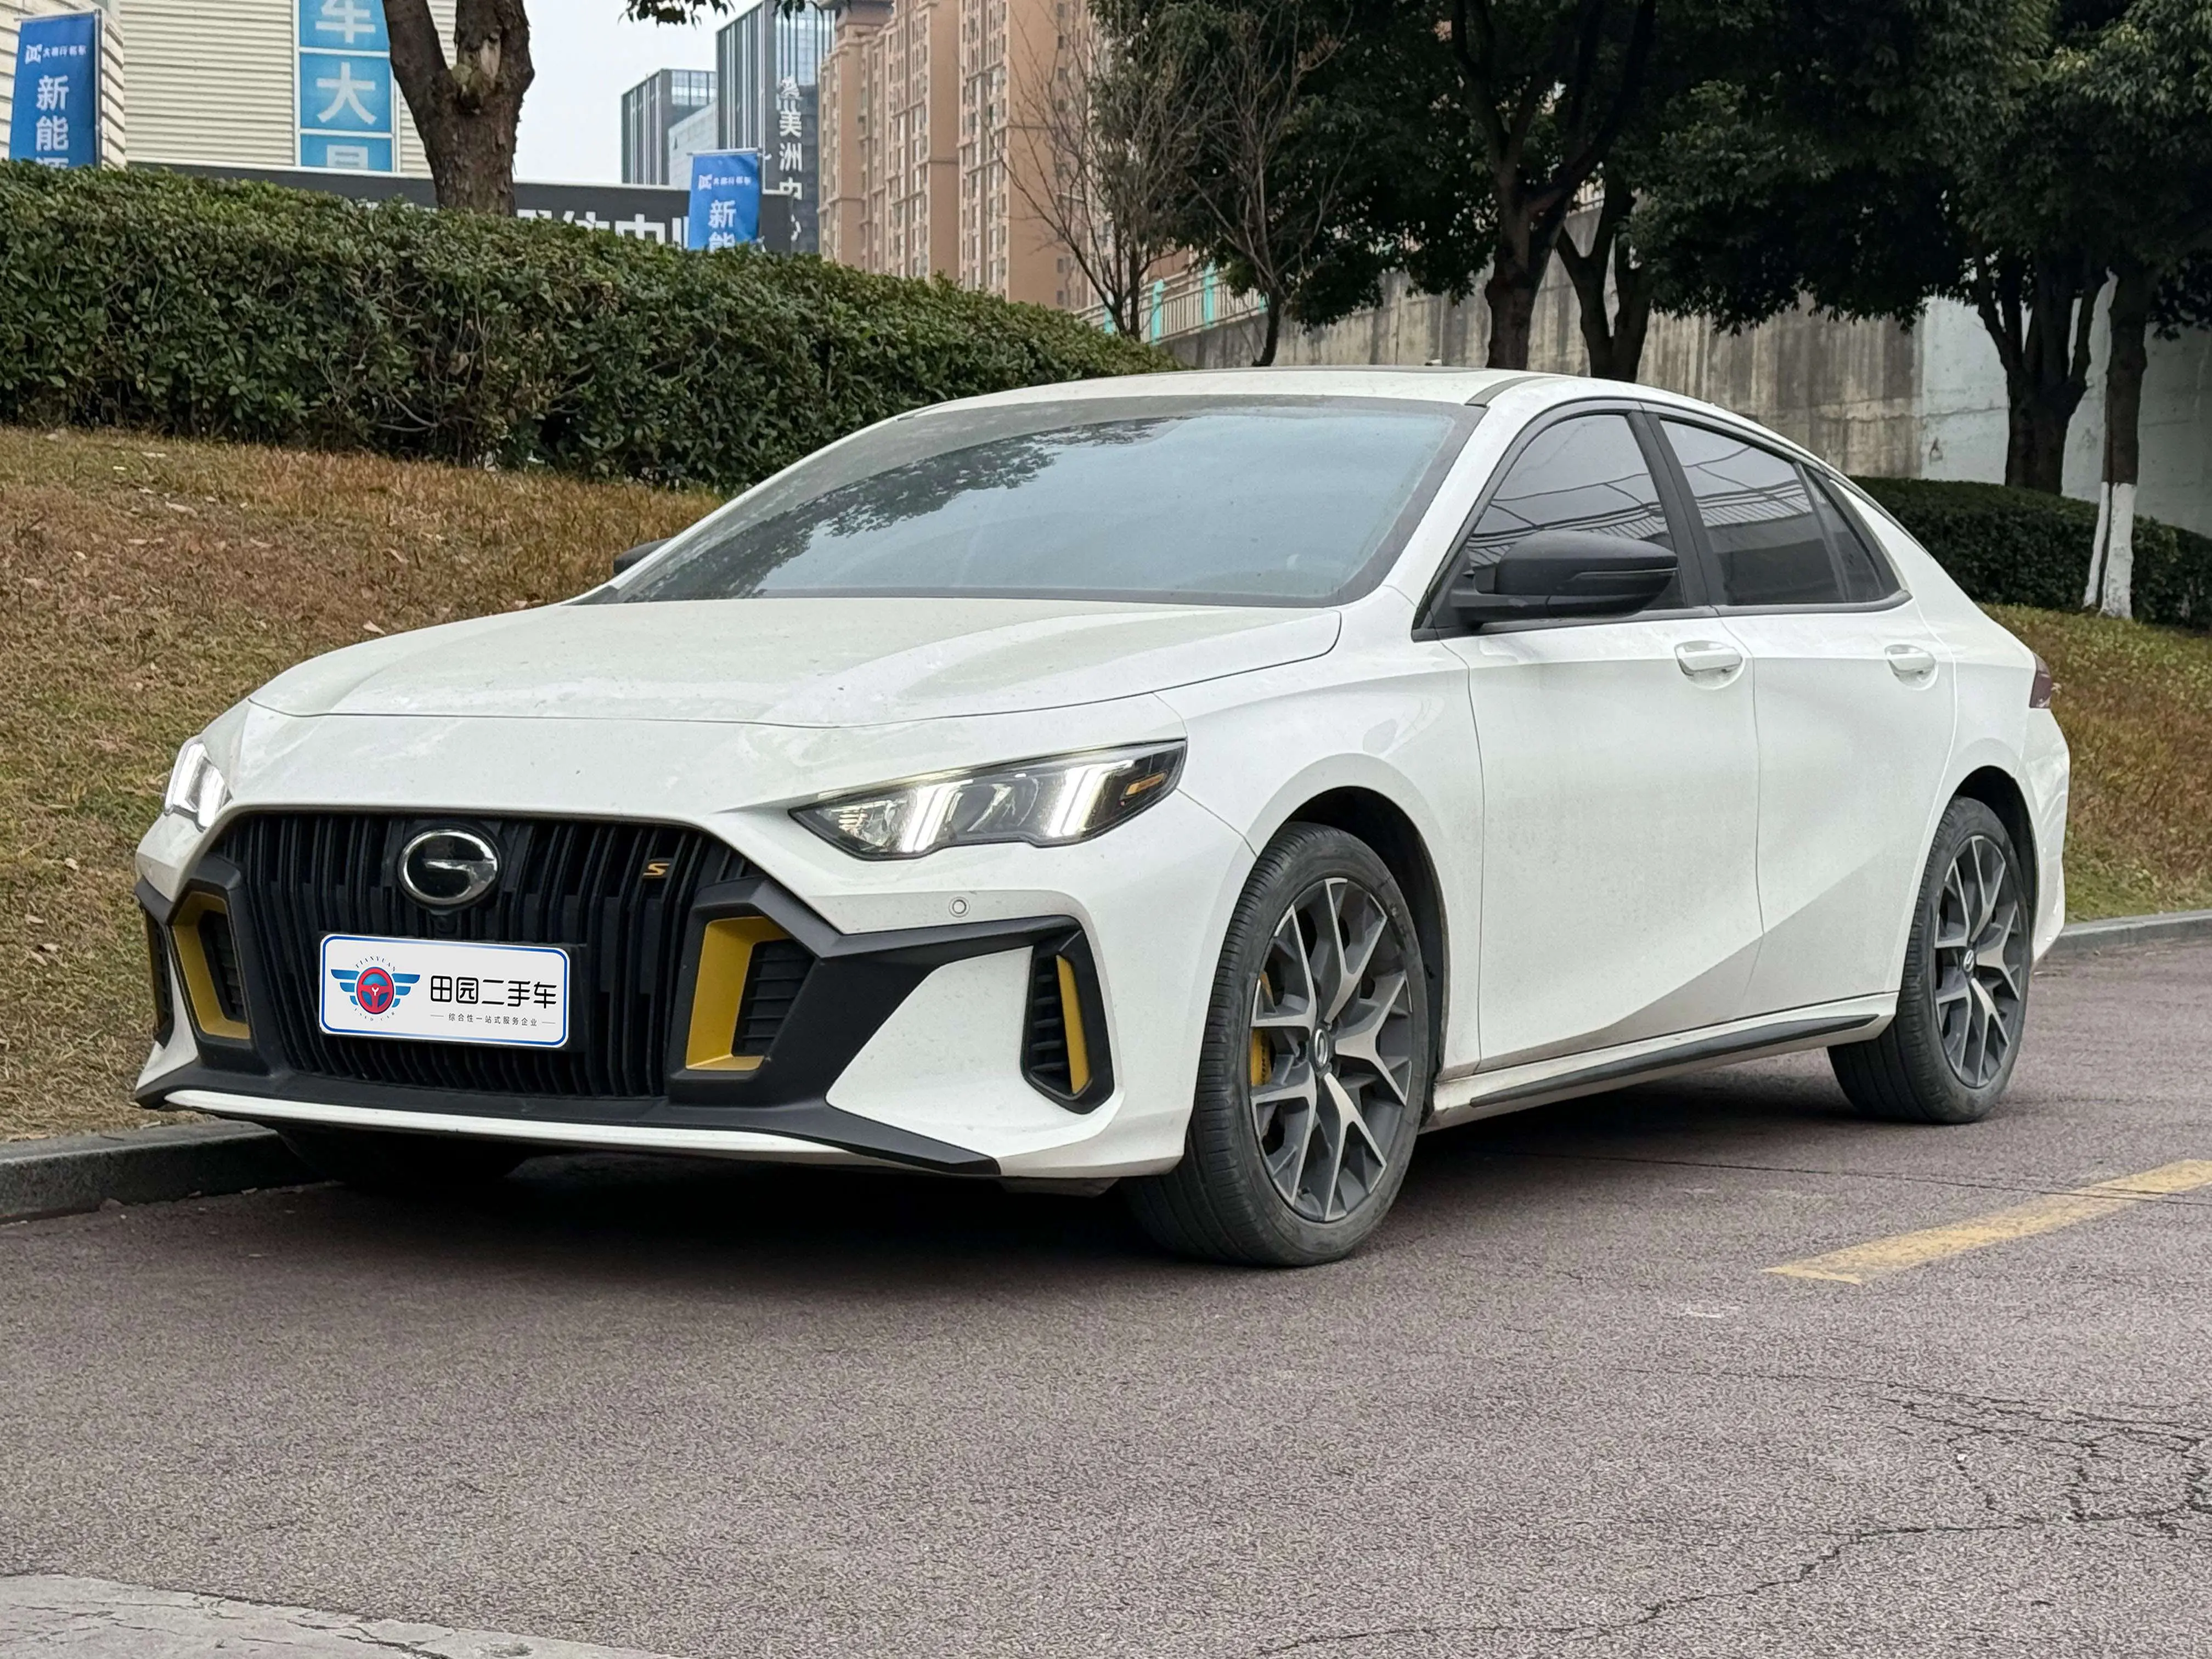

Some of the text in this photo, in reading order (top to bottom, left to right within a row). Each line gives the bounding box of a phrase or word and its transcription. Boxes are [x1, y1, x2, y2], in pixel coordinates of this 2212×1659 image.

[642, 863, 672, 876] S
[430, 975, 557, 1009] 田园二手车
[448, 1013, 538, 1027] 综合性一站式服务企业
